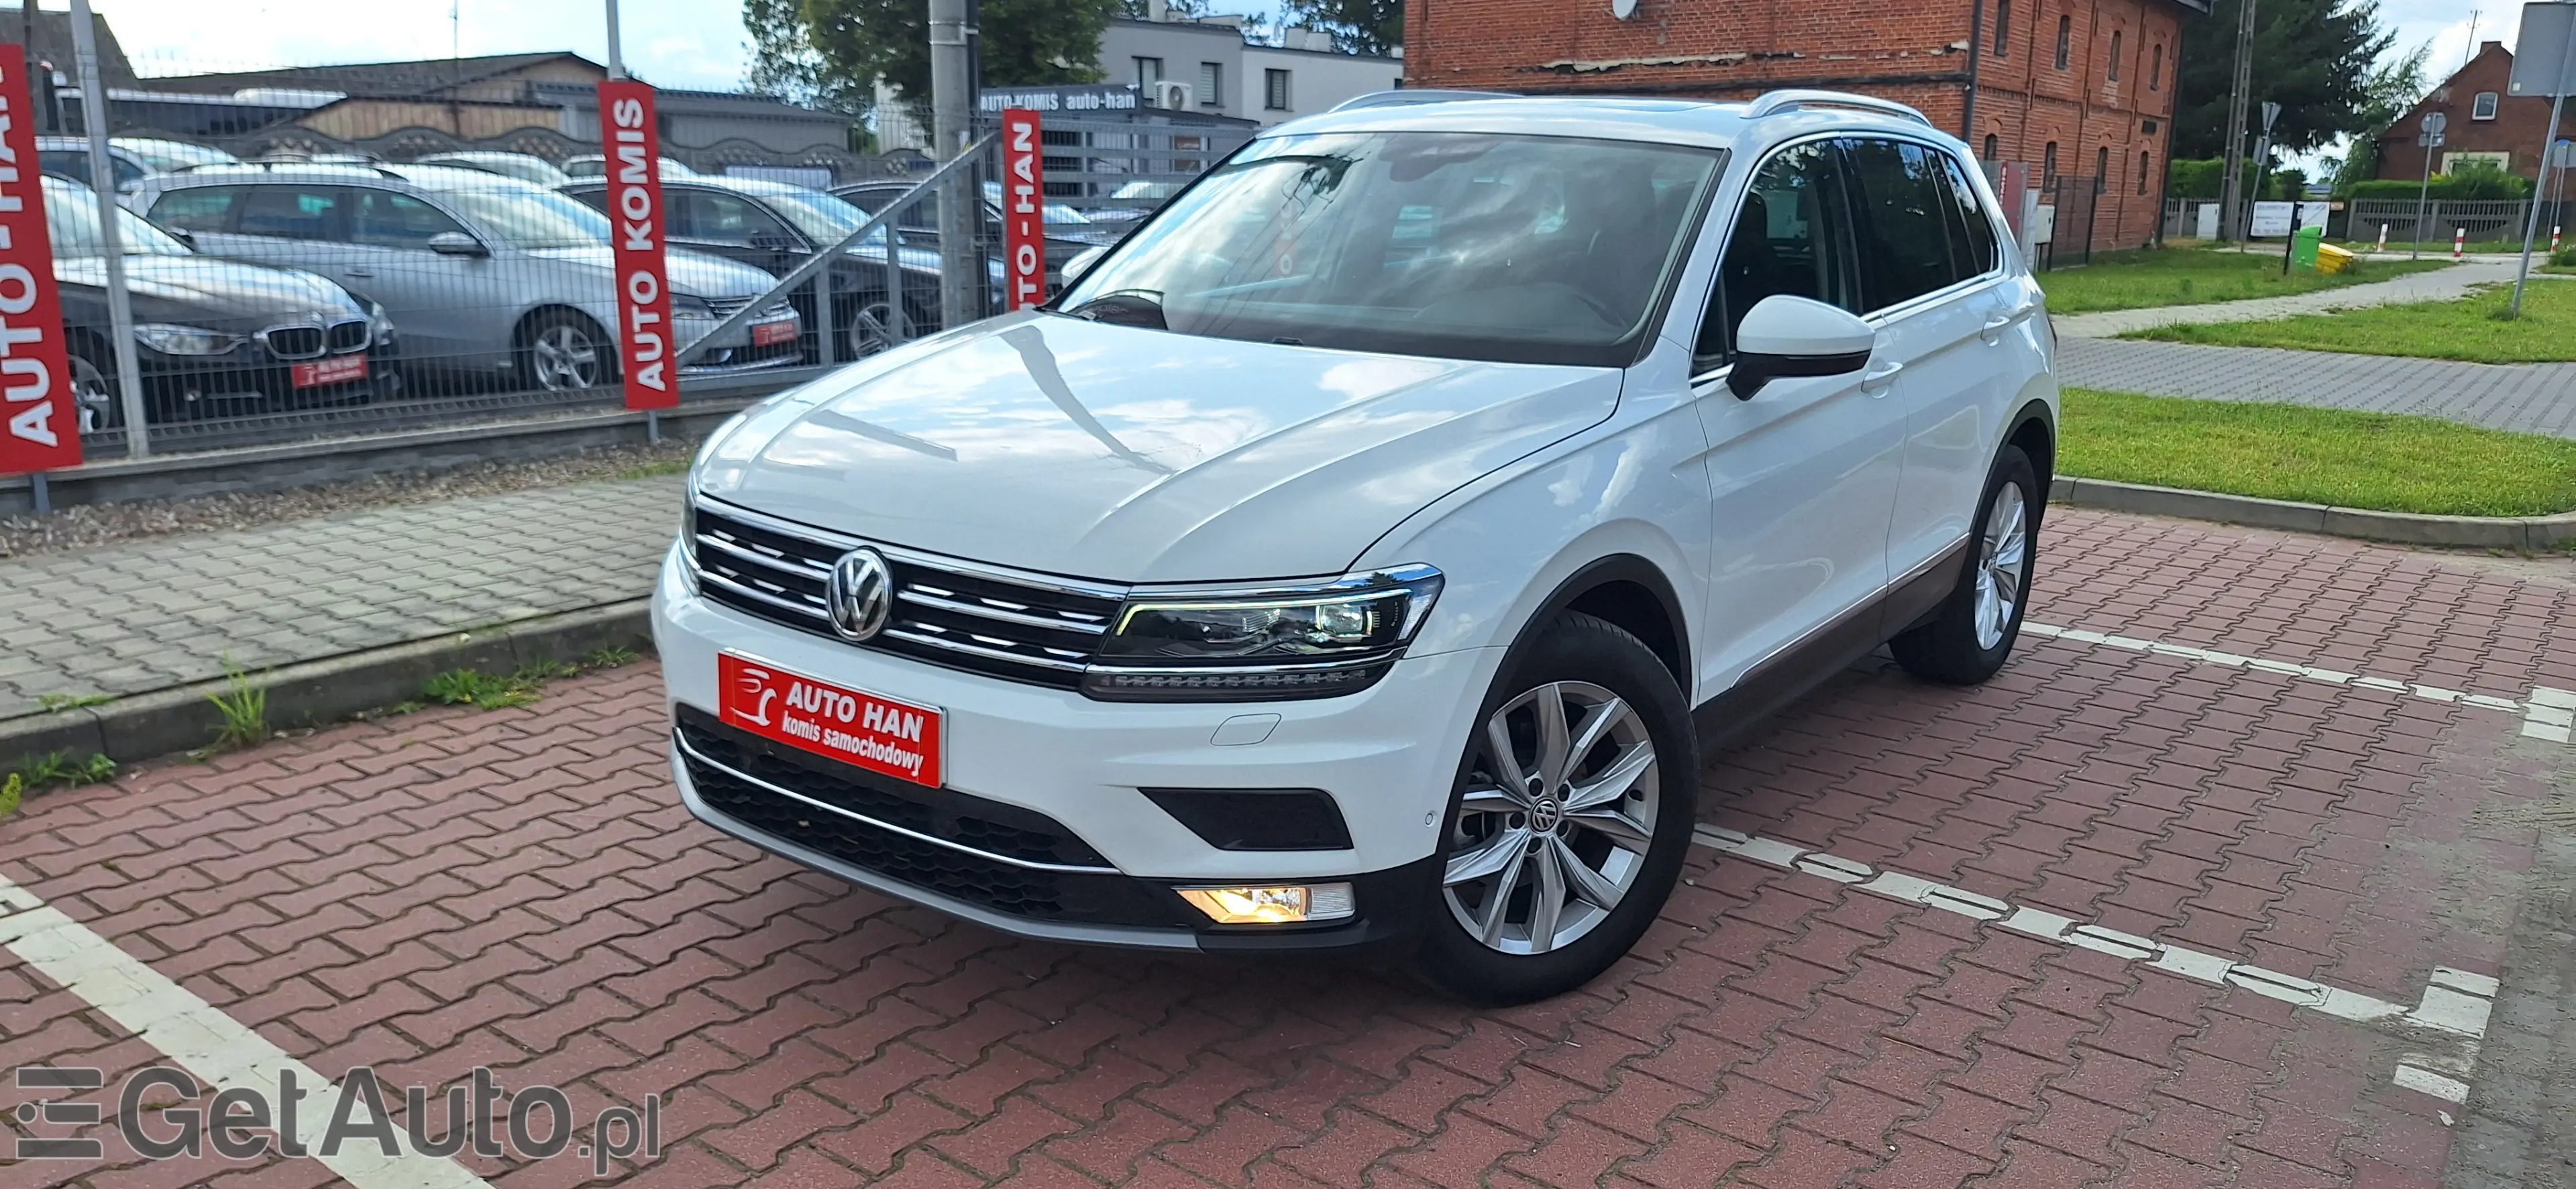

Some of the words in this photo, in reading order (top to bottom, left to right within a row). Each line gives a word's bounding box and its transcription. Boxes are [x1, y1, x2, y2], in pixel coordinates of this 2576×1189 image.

[1065, 91, 1136, 110] auto-han
[613, 97, 654, 251] KOMIS
[629, 270, 666, 392] AUTO
[782, 710, 821, 742] komis
[822, 727, 924, 777] samochodowy
[786, 681, 857, 723] AUTO
[863, 701, 924, 743] HAN
